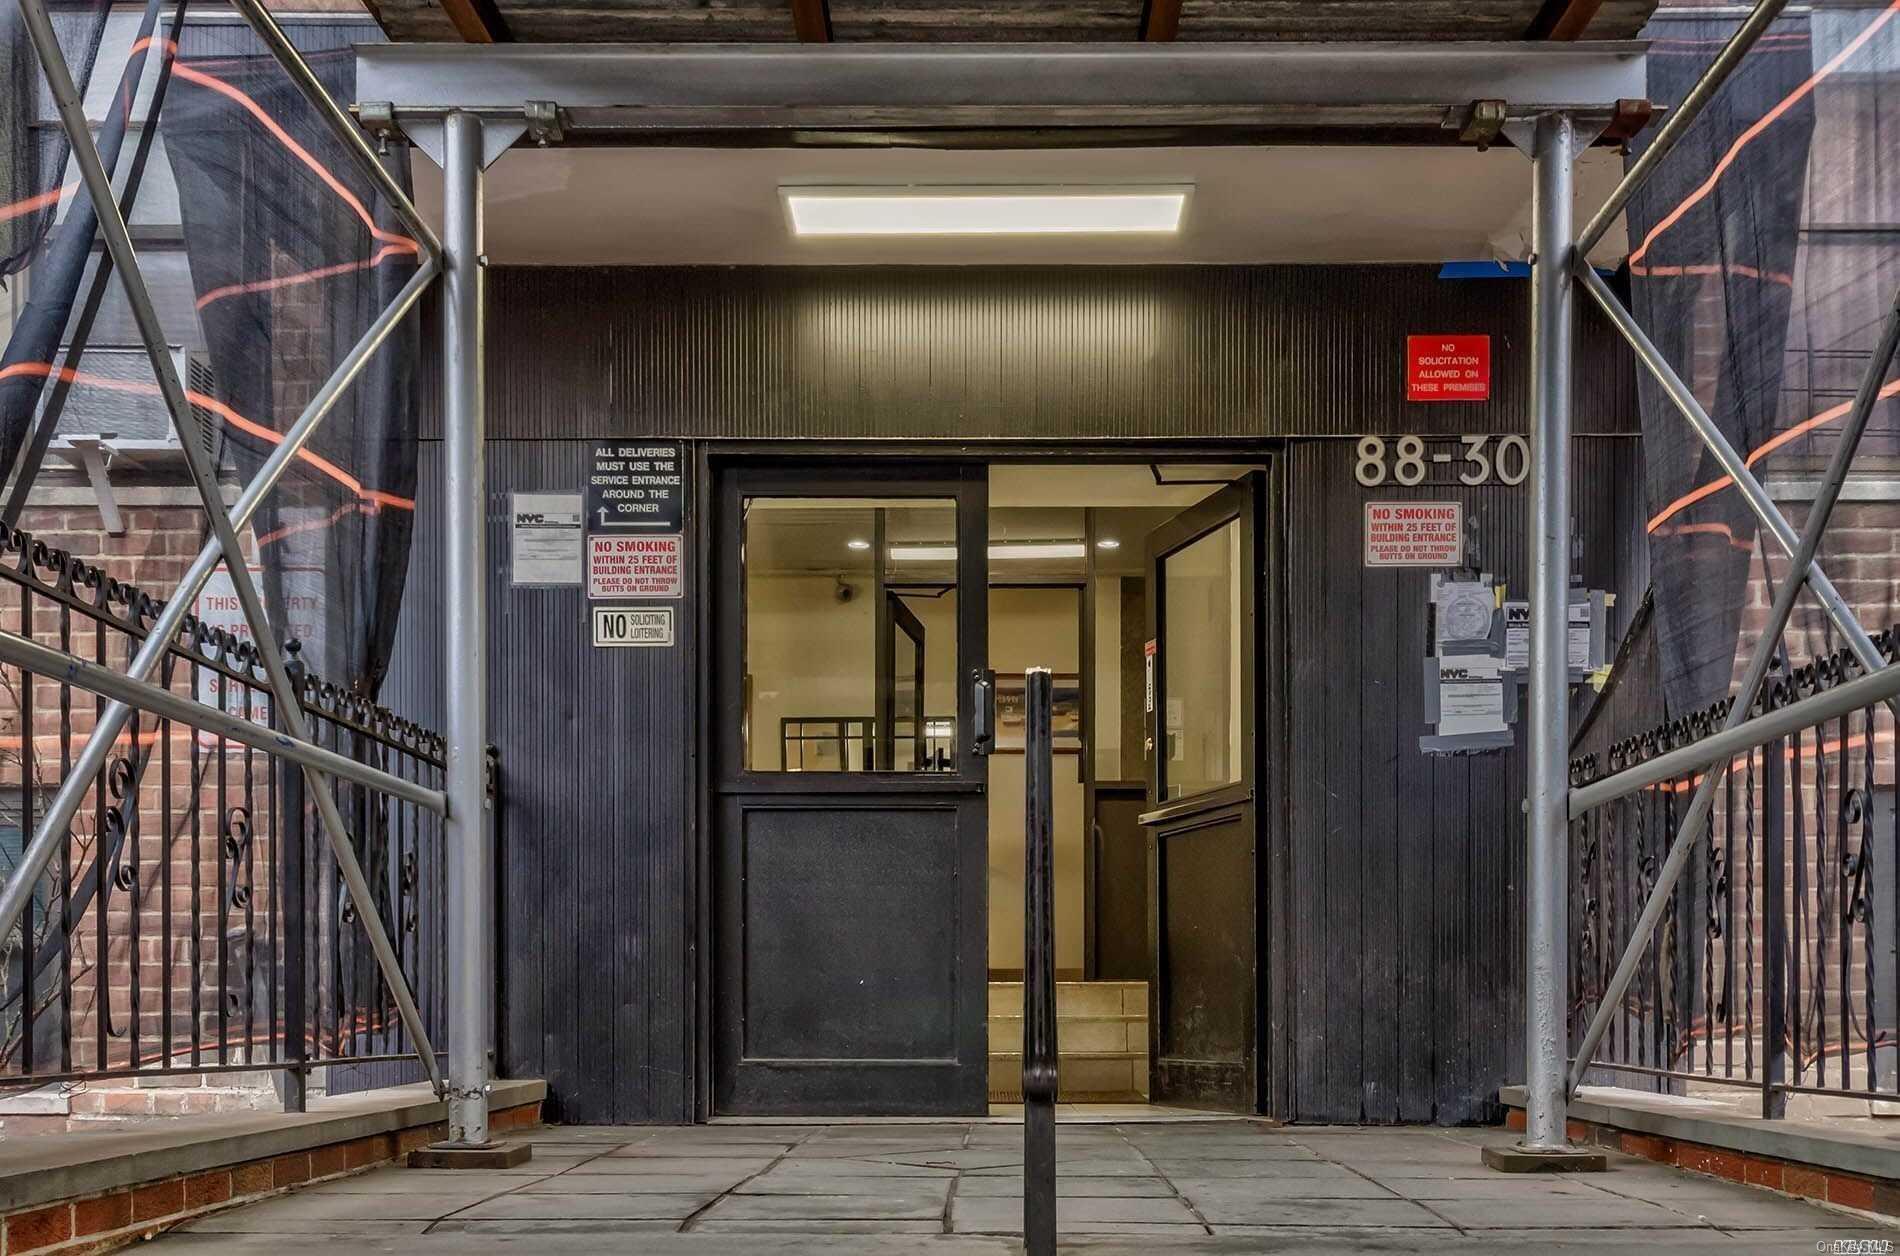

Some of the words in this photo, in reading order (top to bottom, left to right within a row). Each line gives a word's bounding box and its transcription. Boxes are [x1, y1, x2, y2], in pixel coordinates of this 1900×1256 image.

[1418, 357, 1479, 365] SOLICITATION
[1418, 370, 1460, 378] ALLOWED
[1465, 370, 1479, 378] ON
[1412, 383, 1438, 391] THESE
[1443, 383, 1486, 391] PREMISES
[595, 448, 614, 457] ALL
[618, 448, 675, 457] DELIVERIES
[1355, 435, 1530, 487] 88-30
[596, 462, 625, 471] MUST
[629, 462, 650, 471] USE
[654, 462, 675, 471] THE
[591, 476, 628, 485] SERVICE
[632, 476, 680, 485] ENTRANCE
[602, 490, 644, 498] AROUND
[649, 490, 669, 498] THE
[617, 504, 659, 512] CORNER
[1372, 509, 1390, 519] NO
[1395, 509, 1455, 519] SMOKING
[1371, 523, 1404, 532] WITHIN
[1407, 523, 1418, 532] 25
[1420, 523, 1442, 532] FEET
[1445, 523, 1456, 532] OF
[1371, 533, 1410, 542] BUILDING
[1412, 533, 1456, 542] ENTRANCE
[595, 541, 612, 552] NO
[616, 541, 676, 552] SMOKING
[1370, 544, 1398, 552] PLEASE
[1400, 544, 1411, 552] DO
[1413, 544, 1428, 552] NOT
[1429, 544, 1456, 552] THROW
[593, 556, 625, 564] WITHIN
[628, 556, 639, 564] 25
[642, 556, 663, 564] FEET
[666, 556, 678, 564] OF
[593, 566, 632, 575] BUILDING
[634, 566, 677, 575] ENTRANCE
[593, 577, 620, 585] PLEASE
[622, 577, 632, 585] DO
[634, 577, 649, 585] NOT
[651, 577, 678, 585] THROW
[207, 597, 239, 610] THIS
[630, 614, 665, 625] SOLICITING
[603, 614, 626, 638] NO
[630, 628, 663, 639] LOITERING
